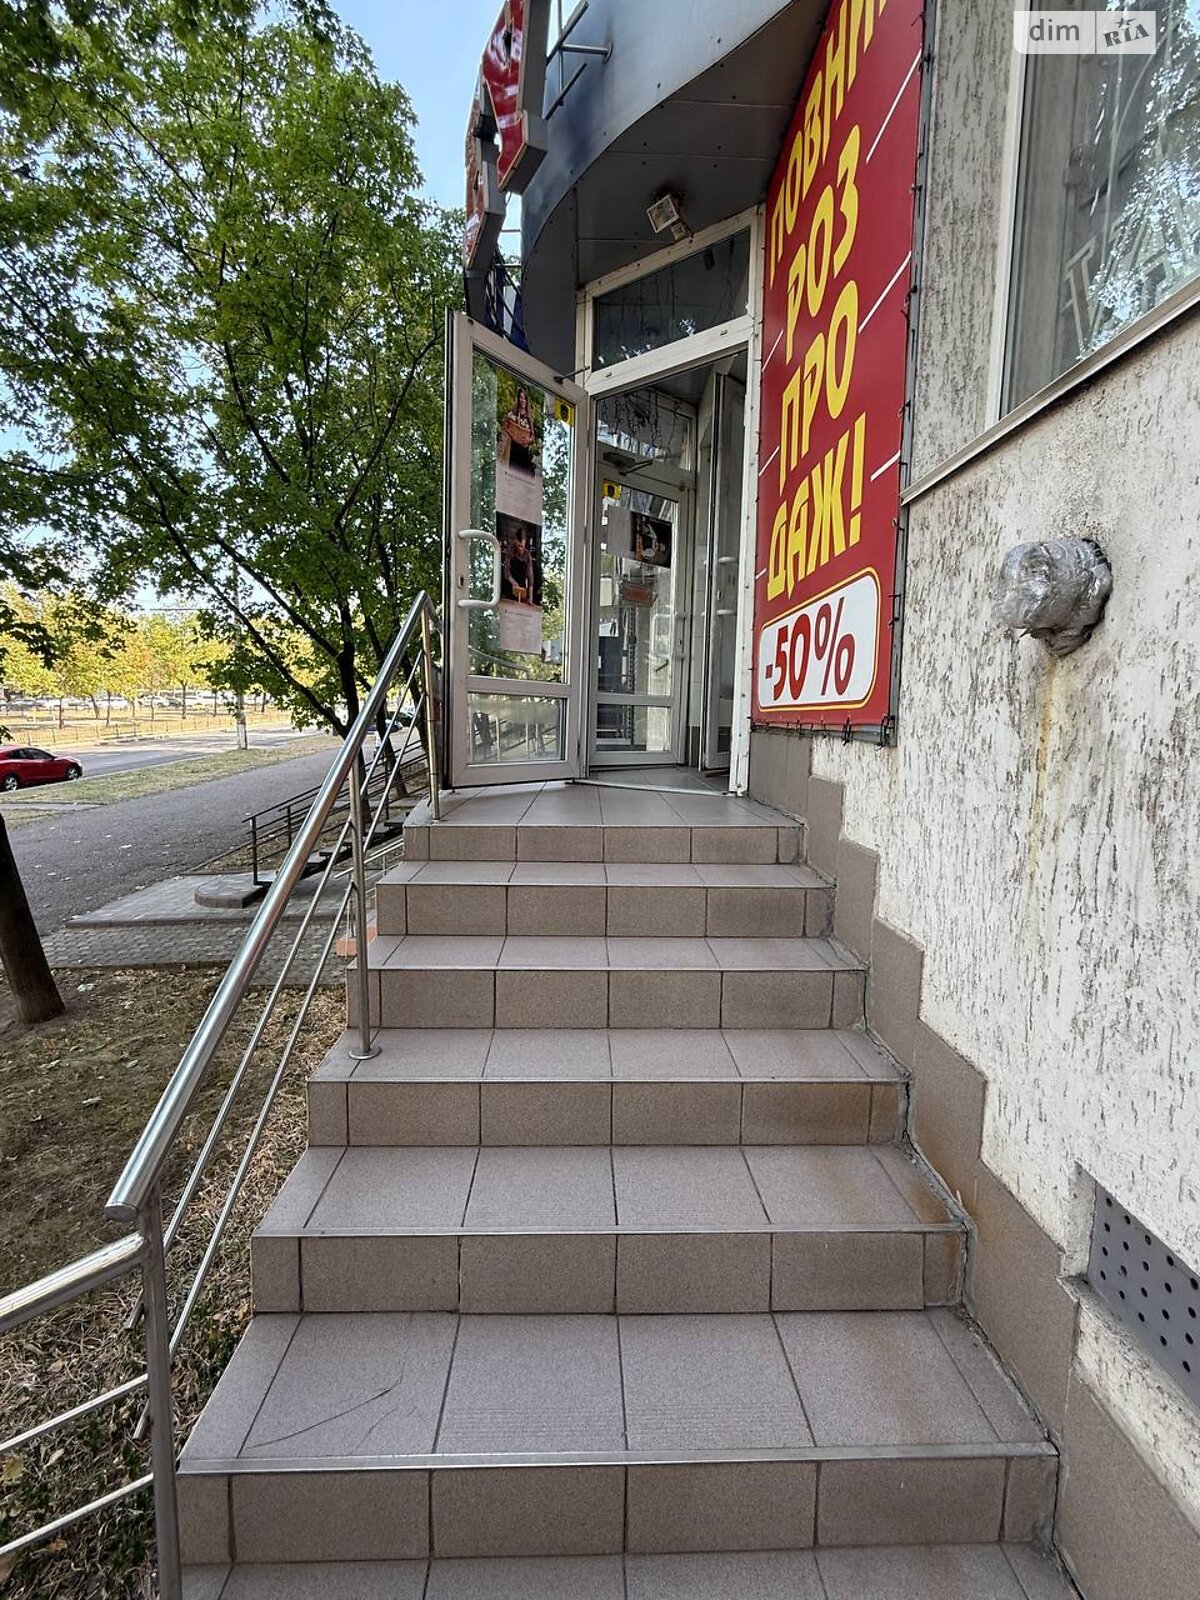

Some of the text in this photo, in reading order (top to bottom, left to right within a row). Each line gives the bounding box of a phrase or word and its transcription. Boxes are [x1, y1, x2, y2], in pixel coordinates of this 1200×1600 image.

[786, 124, 861, 364] РОЗ
[780, 280, 859, 495] ПРО
[767, 411, 867, 602] ДАЖ!
[765, 597, 856, 701] -50%
